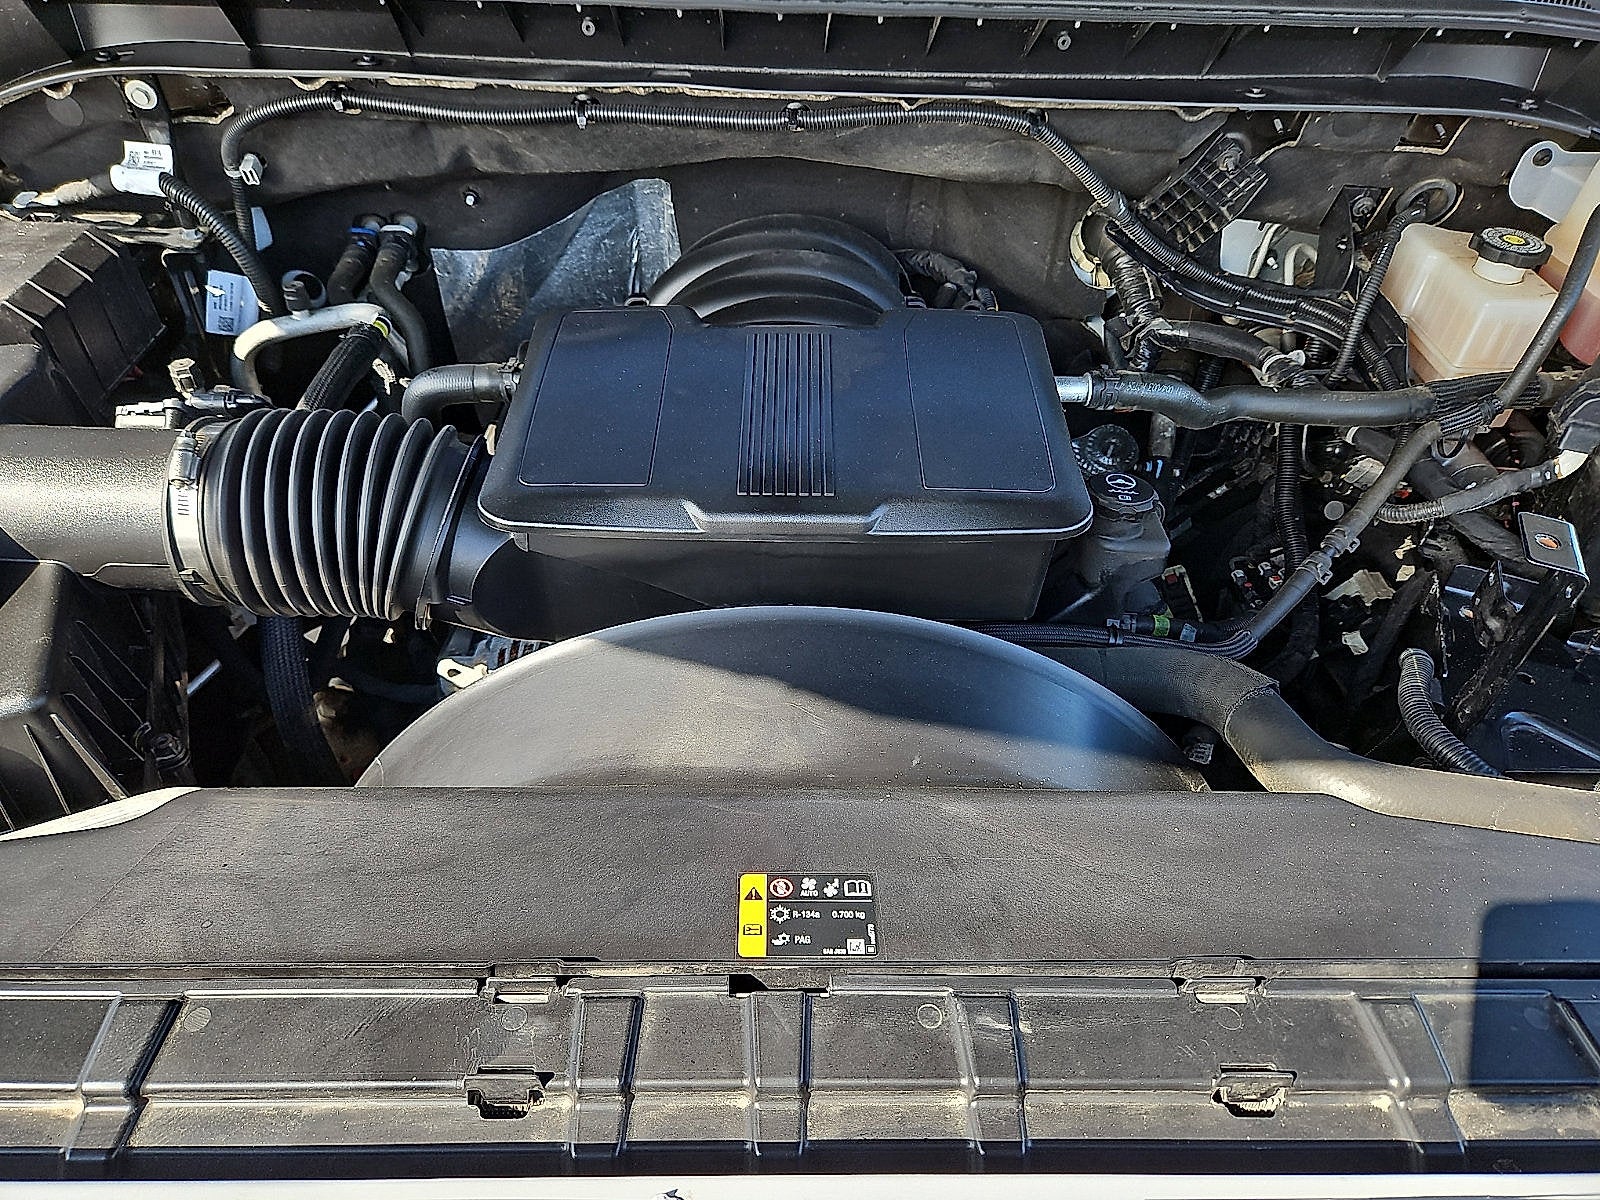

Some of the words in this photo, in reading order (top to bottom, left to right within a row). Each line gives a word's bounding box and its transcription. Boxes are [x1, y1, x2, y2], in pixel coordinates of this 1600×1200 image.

[792, 910, 821, 919] R-134a
[832, 910, 854, 919] 0.700
[855, 910, 866, 920] kg
[794, 935, 811, 945] PAG
